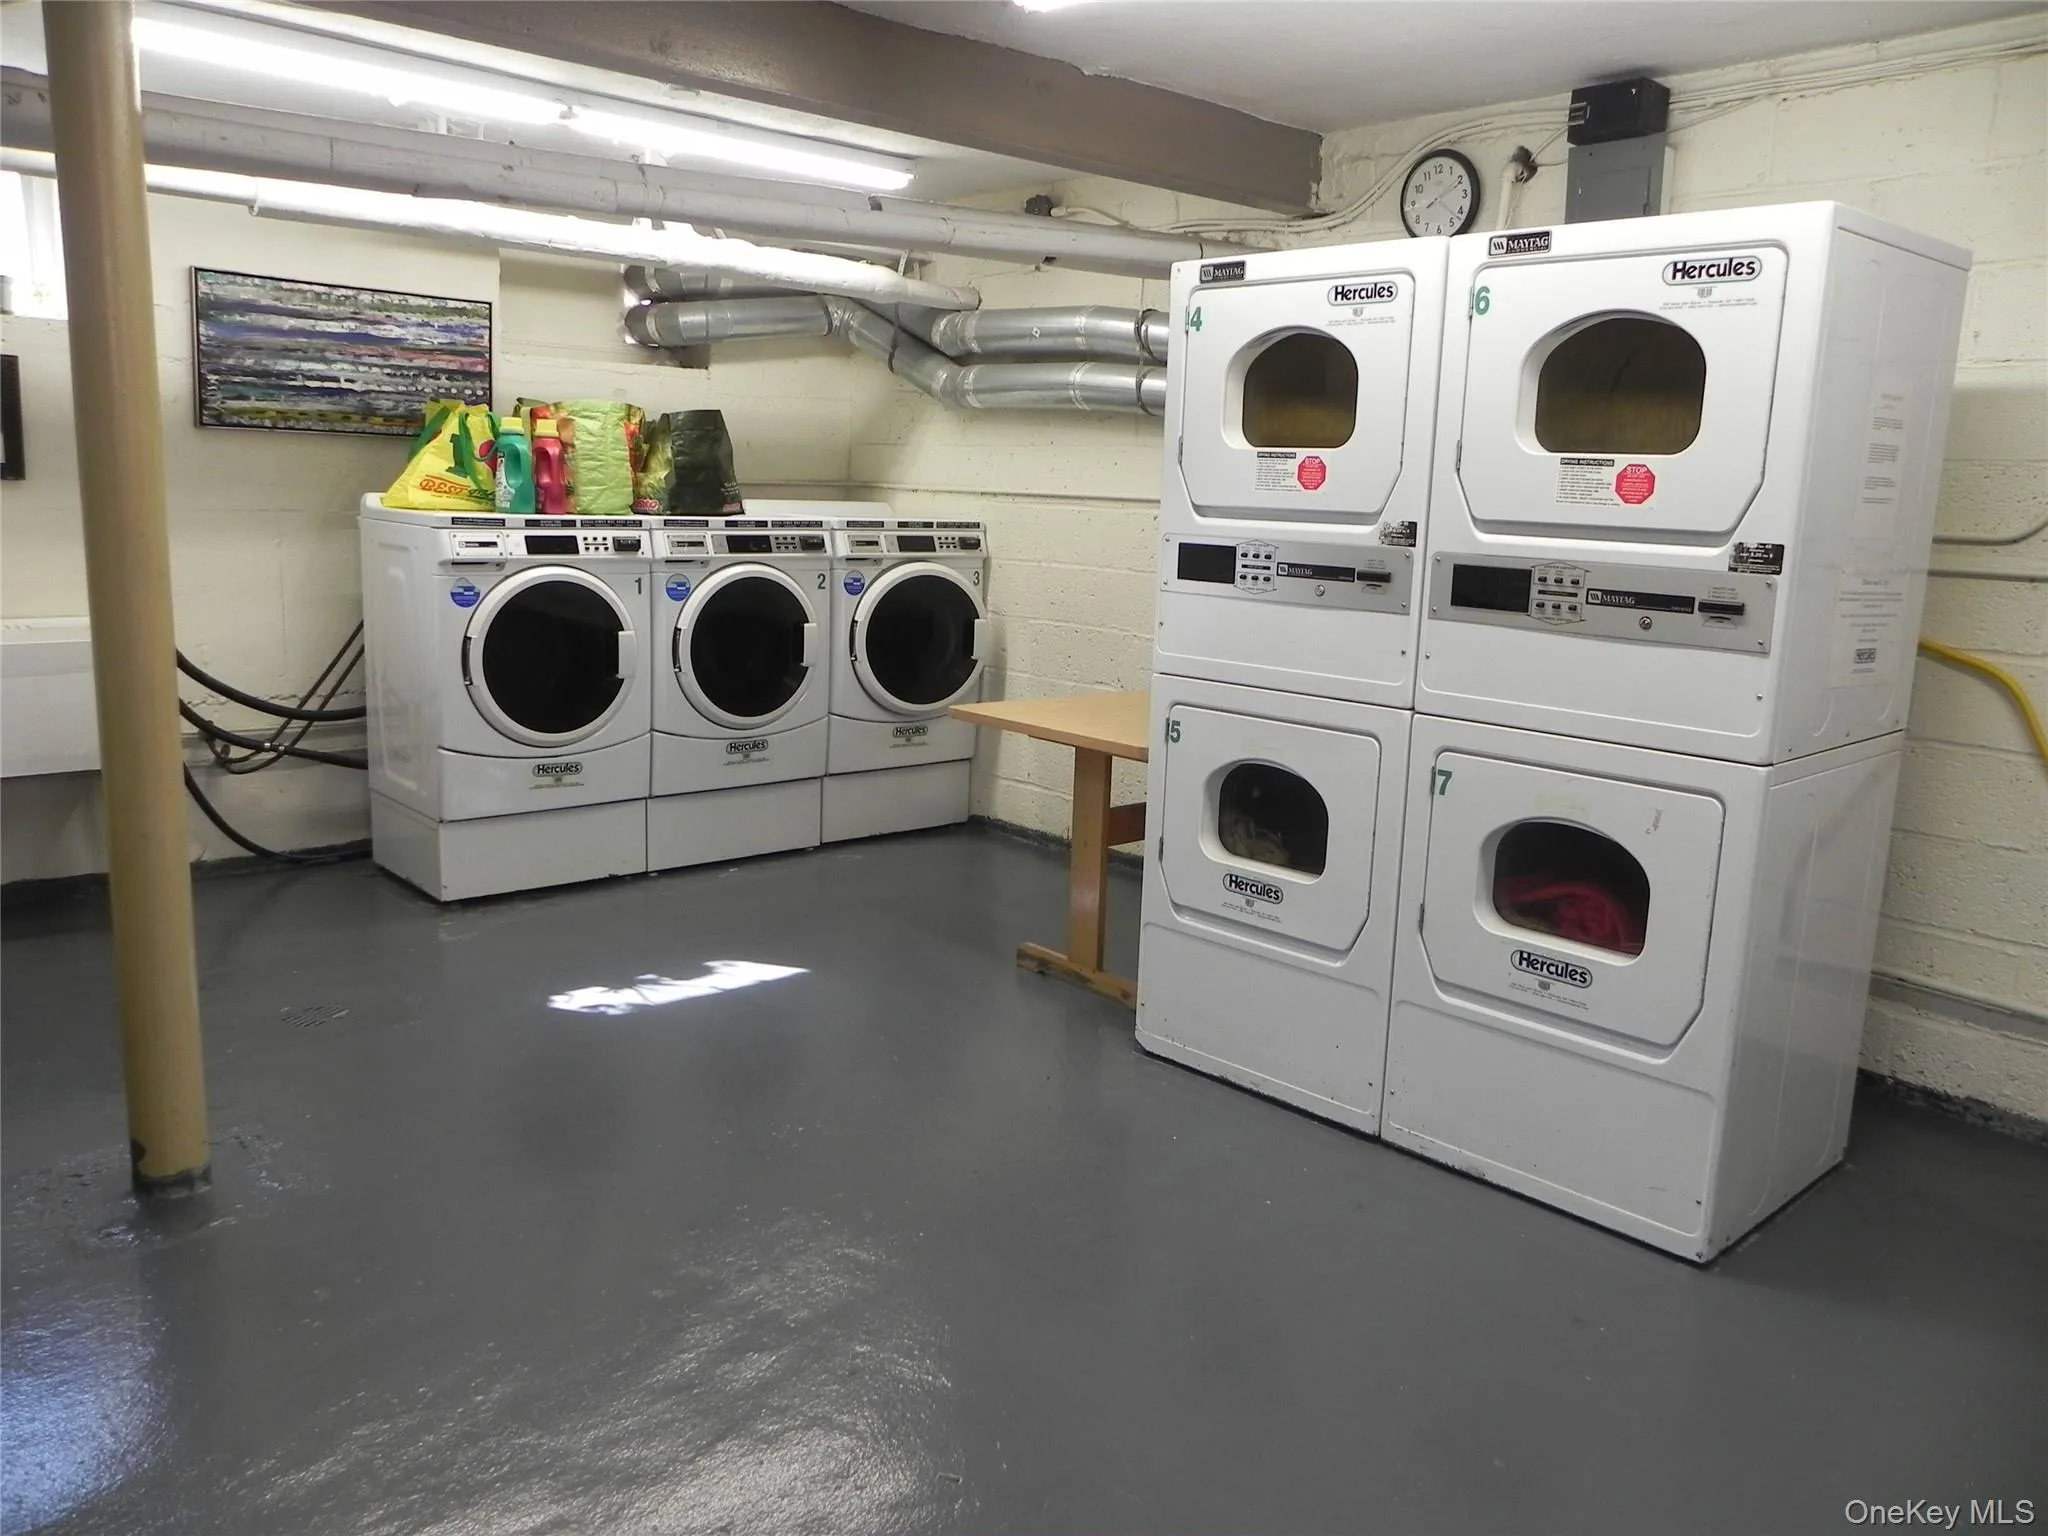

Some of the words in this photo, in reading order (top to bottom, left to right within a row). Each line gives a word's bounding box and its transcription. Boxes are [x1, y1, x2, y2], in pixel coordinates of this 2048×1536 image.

[1434, 164, 1444, 175] 12
[1449, 166, 1454, 176] 1
[1423, 171, 1431, 182] 11
[1456, 175, 1464, 185] 2
[1414, 184, 1424, 195] 10
[1461, 189, 1468, 199] 3
[1410, 200, 1416, 208] 9
[1457, 205, 1464, 215] 4
[1415, 215, 1421, 225] 8
[1448, 217, 1455, 227] 5
[1424, 223, 1430, 232] 7
[1436, 225, 1442, 234] 6
[1508, 236, 1549, 250] MAYTAG
[1213, 266, 1244, 277] MAYTAG
[1671, 257, 1756, 281] Hercules
[1333, 283, 1394, 302] Hercules
[1475, 286, 1490, 315] 6
[1190, 306, 1203, 332] 4
[1626, 466, 1648, 474] STOP
[1288, 567, 1313, 575] MAYTAG
[817, 573, 826, 590] 2
[973, 571, 980, 586] 3
[635, 577, 642, 595] 1
[1602, 594, 1635, 604] MAYTAG
[1169, 721, 1181, 743] 5
[730, 740, 766, 751] Hercules
[537, 763, 579, 774] Hercules
[1437, 769, 1453, 796] 7
[1229, 874, 1280, 901] Hercules
[1518, 950, 1588, 984] Hercules
